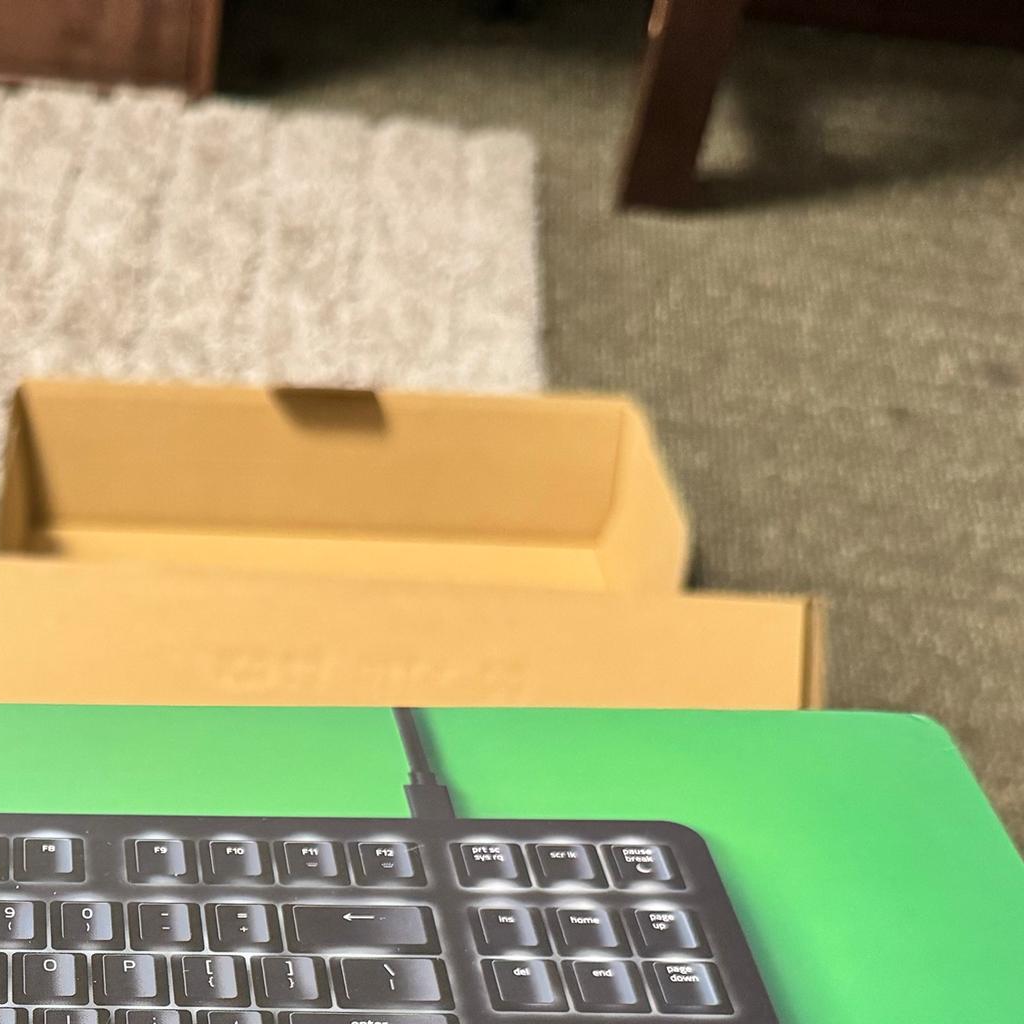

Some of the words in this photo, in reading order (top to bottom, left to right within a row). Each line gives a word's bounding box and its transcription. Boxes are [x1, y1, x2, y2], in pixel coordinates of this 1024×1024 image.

[302, 848, 318, 856] F11
[622, 848, 652, 857] pause
[625, 855, 654, 863] break
[4, 907, 15, 918] 9
[498, 915, 515, 923] ins
[570, 916, 600, 925] home
[649, 913, 675, 923] page
[652, 923, 667, 931] up
[43, 959, 57, 972] O
[124, 960, 136, 972] P
[666, 965, 692, 975] page
[513, 968, 530, 976] del
[592, 969, 612, 977] end
[670, 974, 699, 983] down
